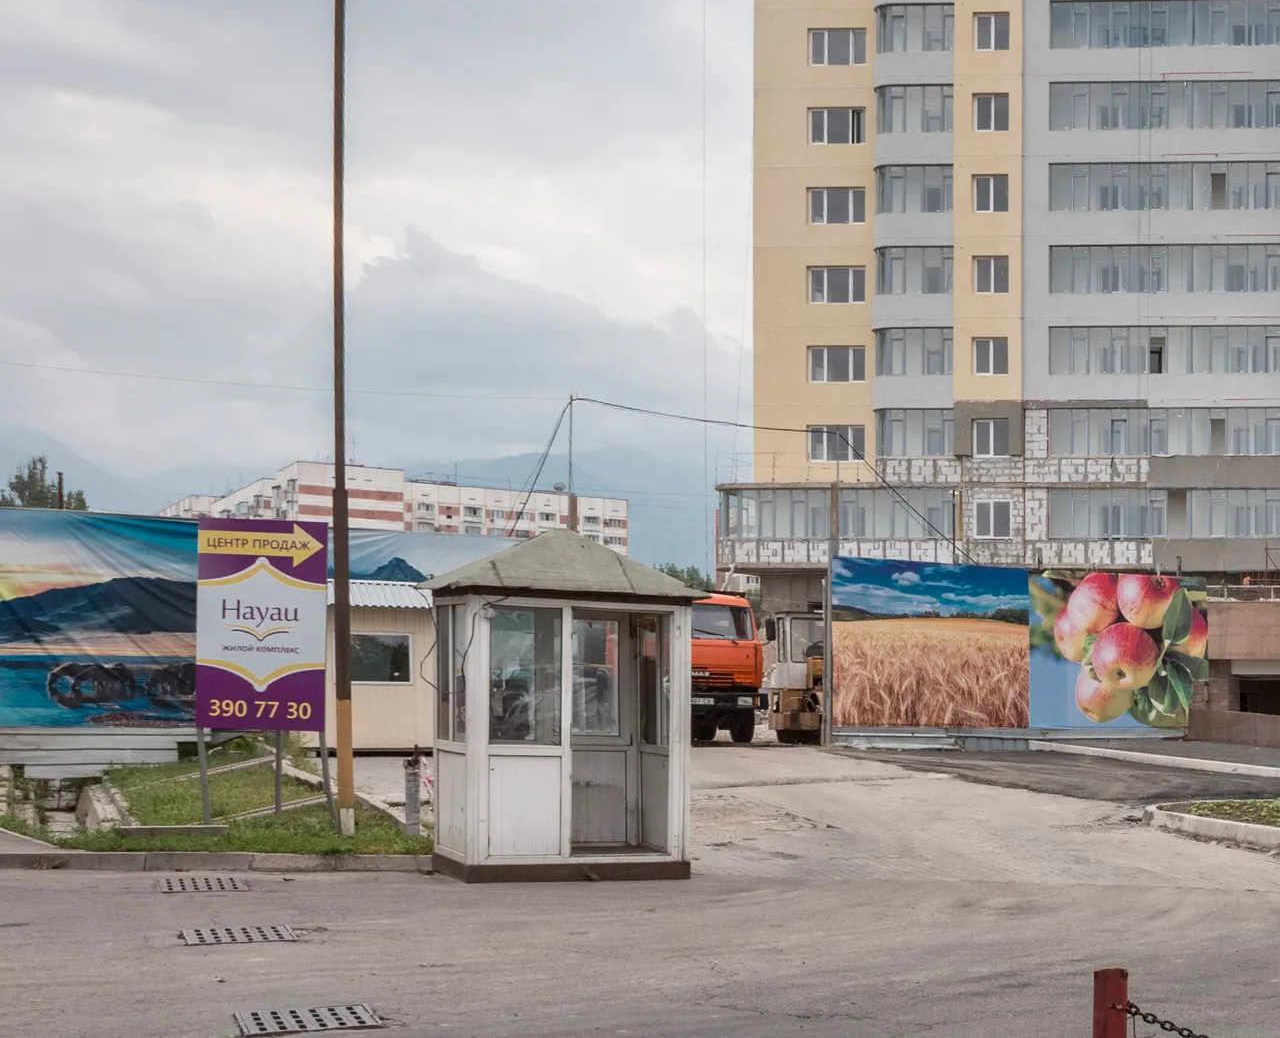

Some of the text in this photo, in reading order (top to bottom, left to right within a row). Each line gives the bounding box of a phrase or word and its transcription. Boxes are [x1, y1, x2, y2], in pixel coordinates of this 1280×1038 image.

[207, 537, 311, 552] ЦЕНТР ПРОДАЖ
[222, 598, 300, 628] Hayau
[222, 644, 300, 654] ЖИЛОЙ КОМПЛЕКС
[208, 699, 312, 720] 390 77 30
